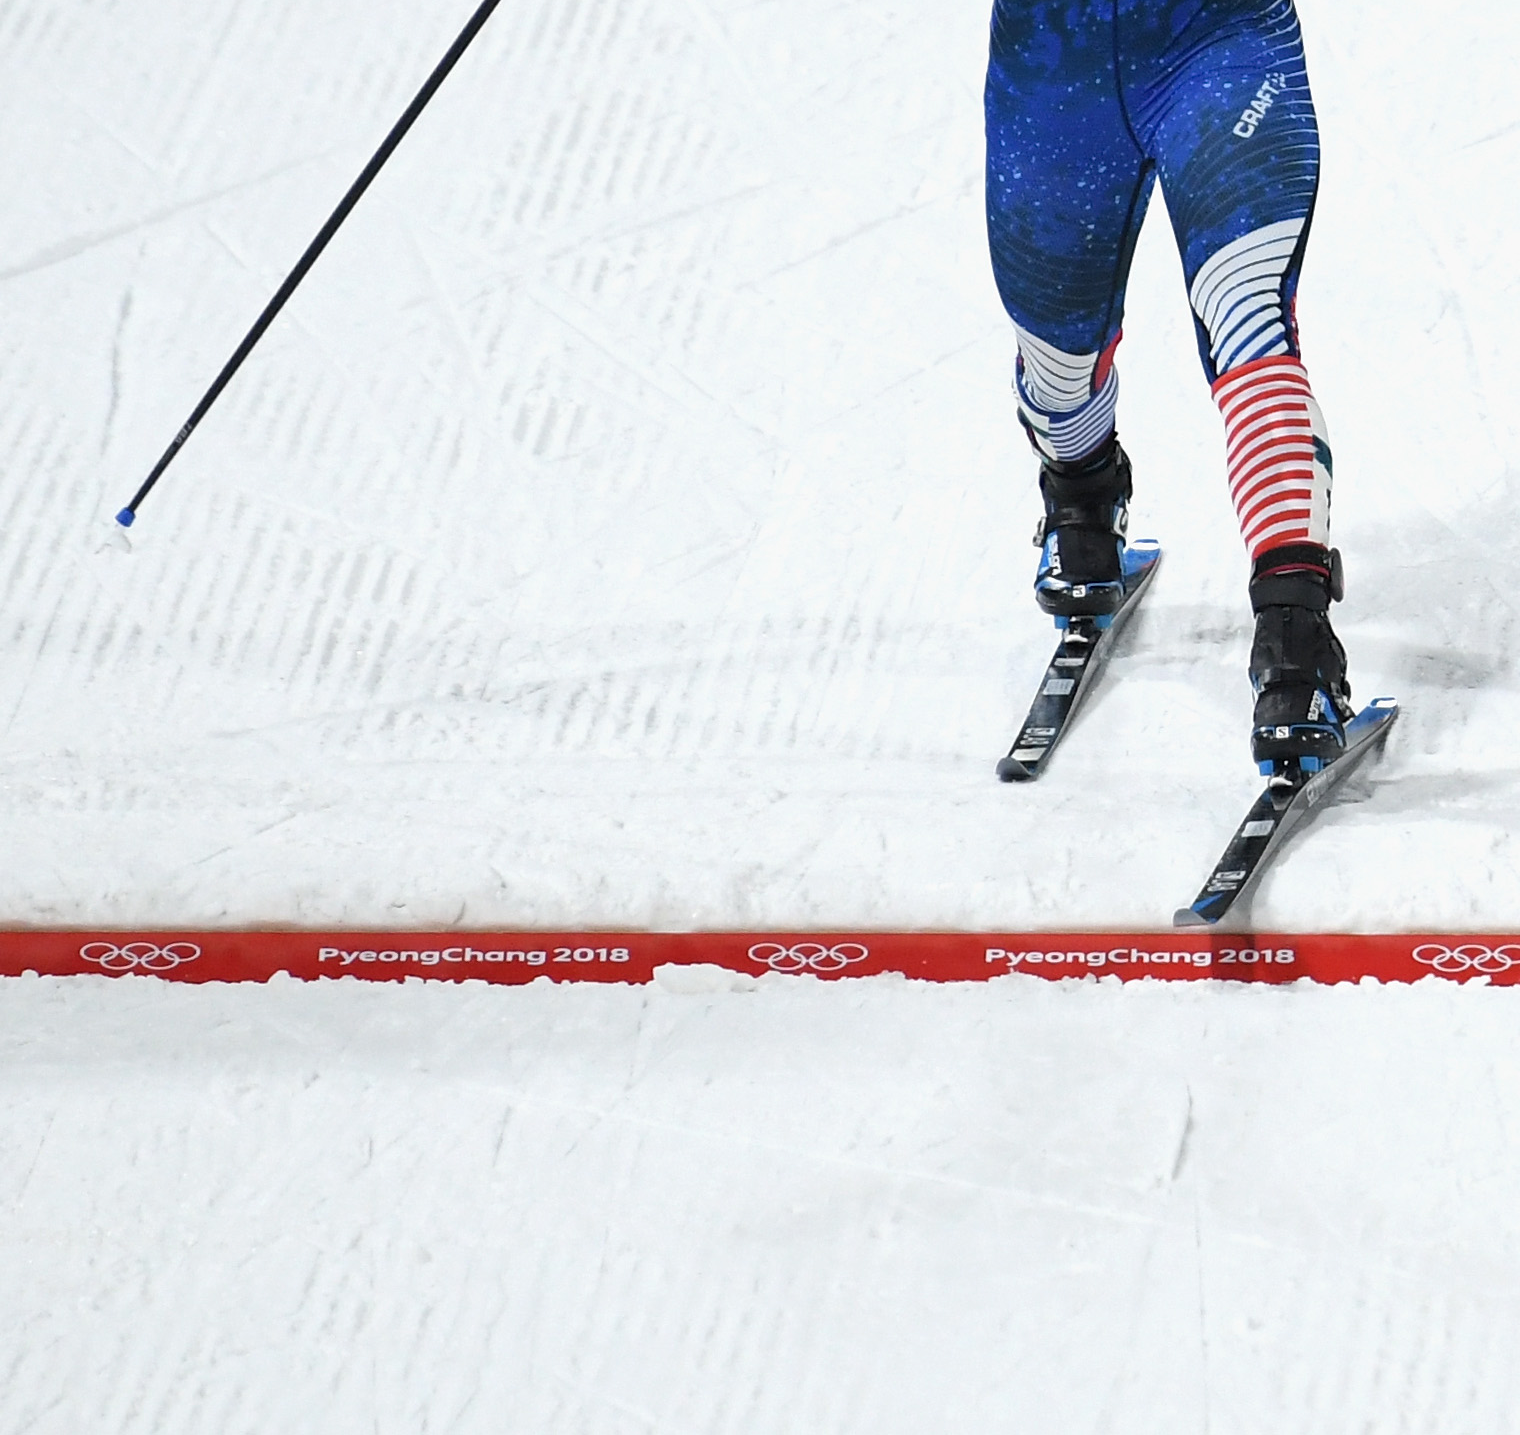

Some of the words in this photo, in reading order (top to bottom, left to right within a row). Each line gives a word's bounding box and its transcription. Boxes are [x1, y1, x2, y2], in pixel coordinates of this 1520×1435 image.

[1232, 80, 1280, 139] CRAFT
[318, 947, 547, 966] PyeongChang
[552, 947, 630, 963] 2018
[985, 948, 1212, 967] PyeongChang
[1218, 948, 1295, 964] 2018
